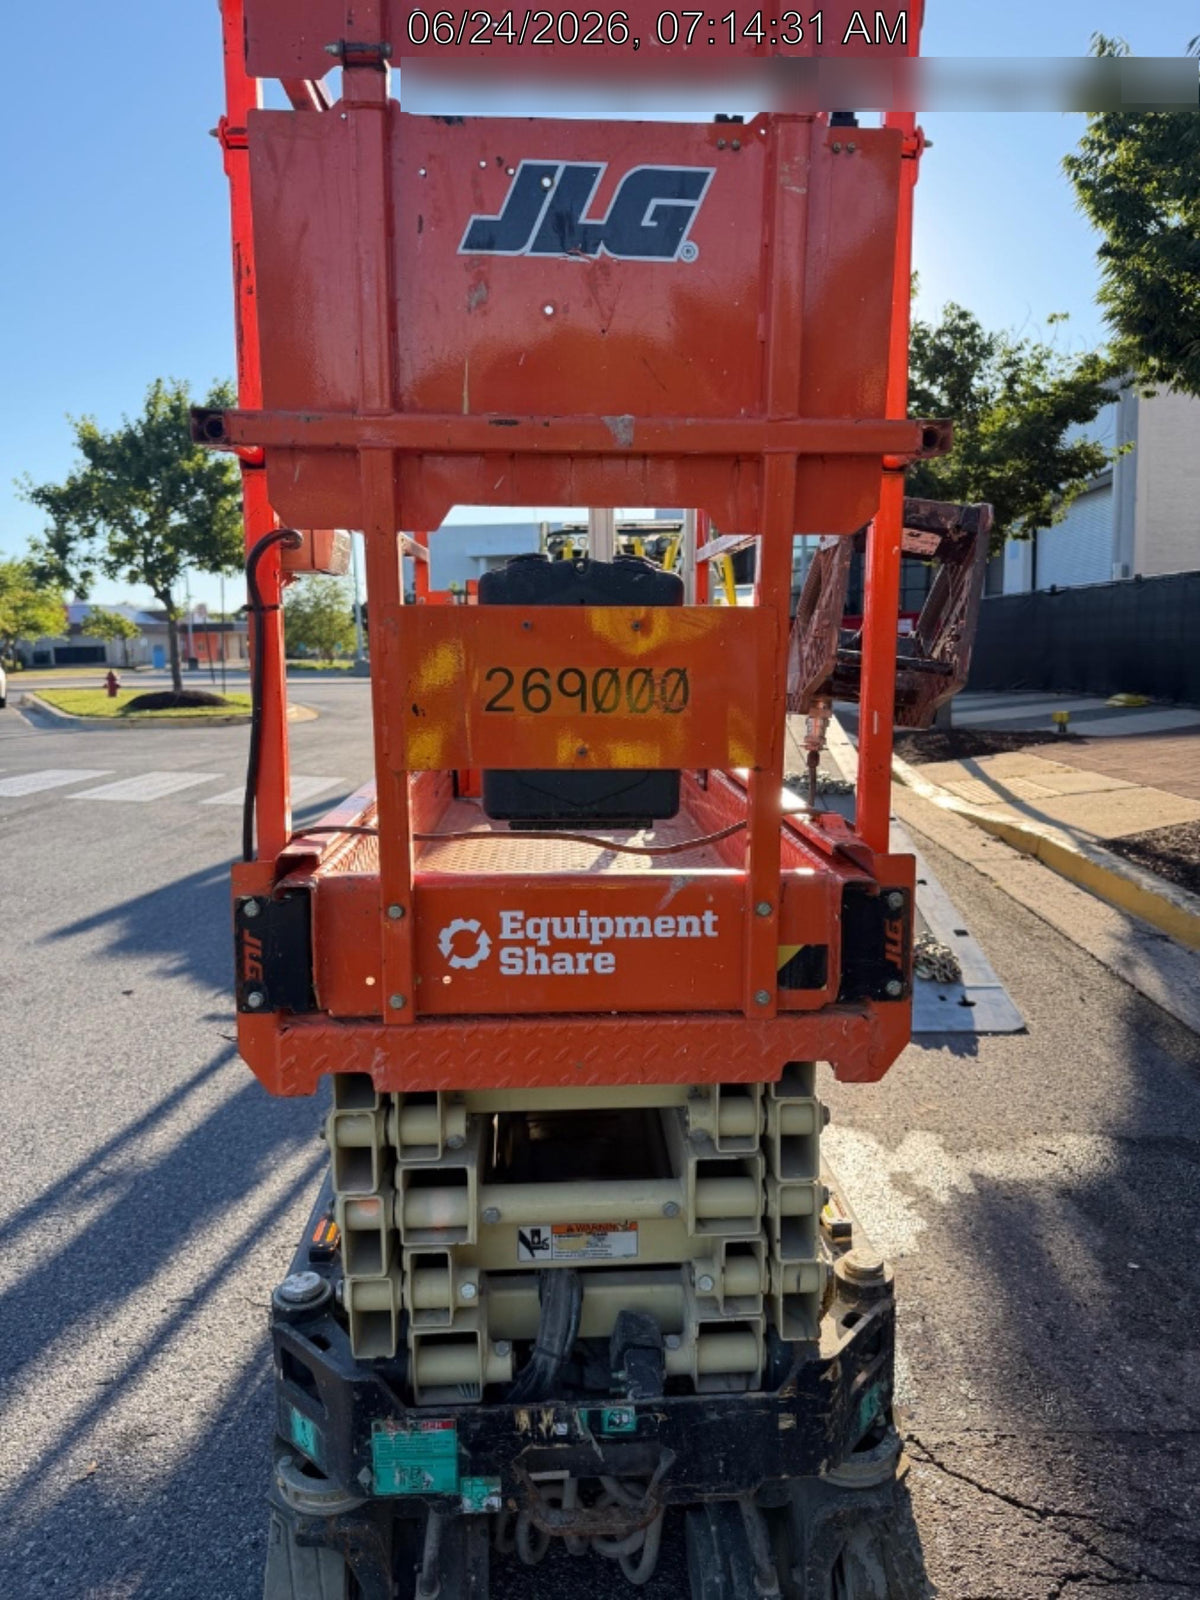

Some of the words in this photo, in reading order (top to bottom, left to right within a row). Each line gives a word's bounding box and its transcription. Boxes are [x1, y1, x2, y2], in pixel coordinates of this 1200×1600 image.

[484, 667, 690, 714] 269000
[499, 909, 719, 946] Equipment
[884, 919, 904, 971] JLG
[242, 927, 263, 982] JLG
[500, 946, 616, 975] Share
